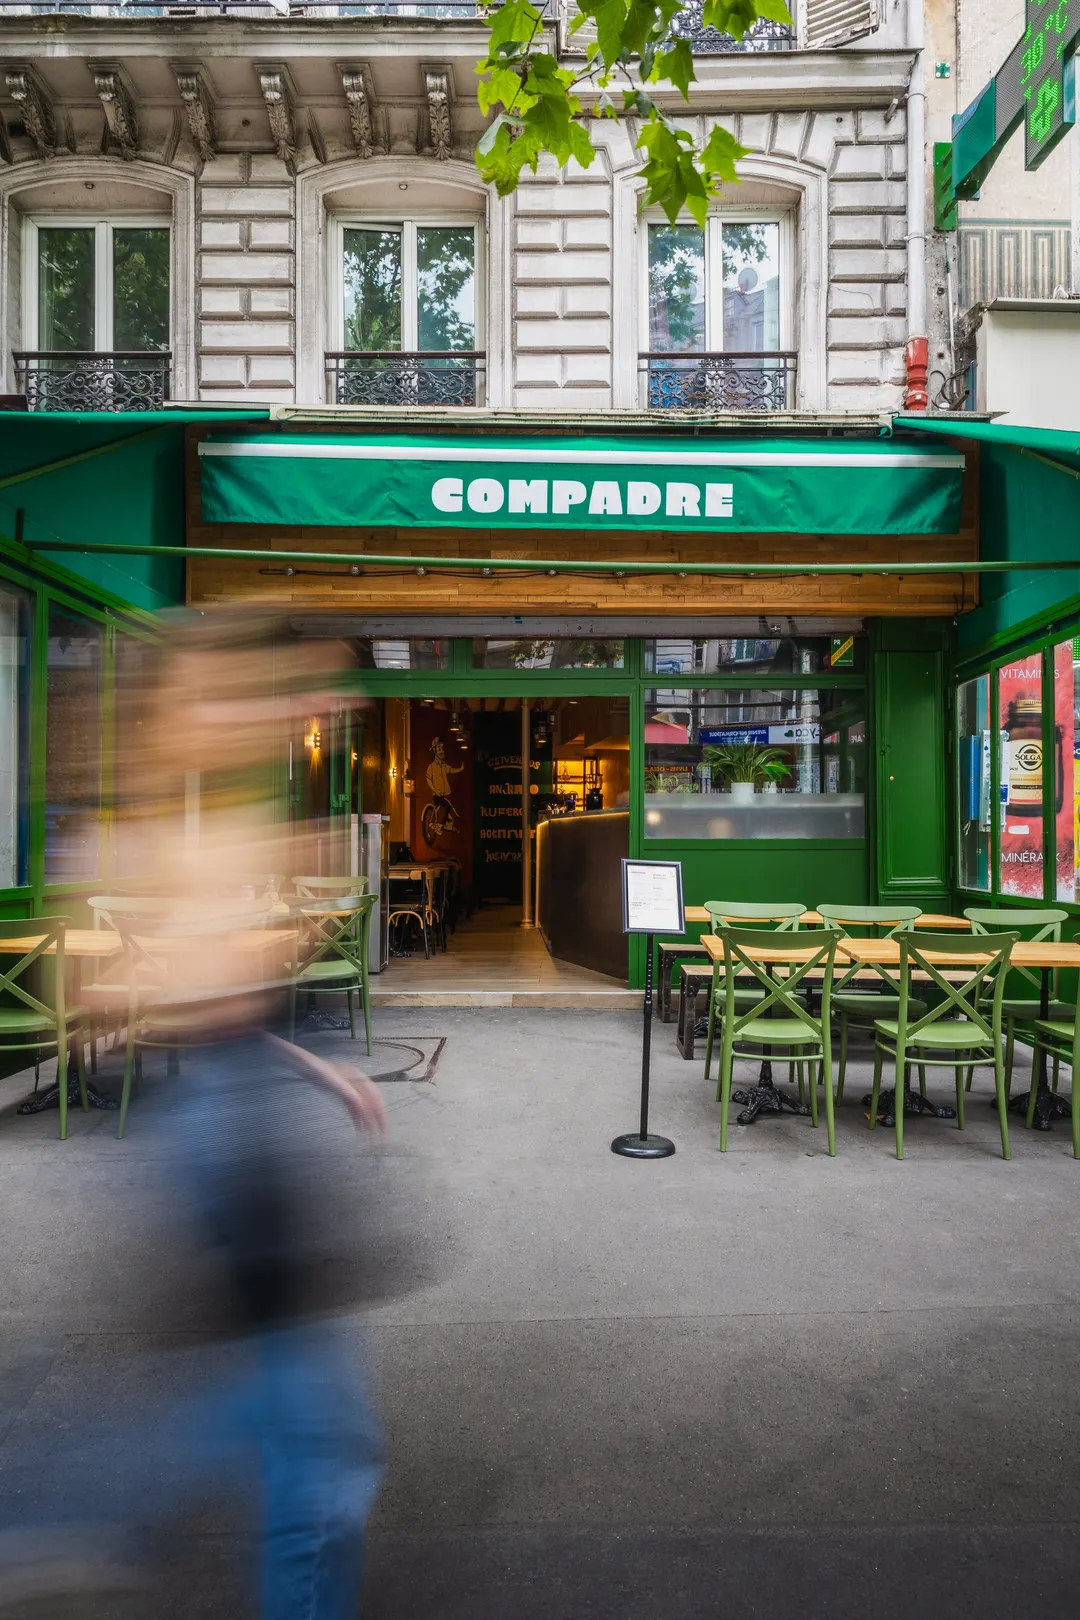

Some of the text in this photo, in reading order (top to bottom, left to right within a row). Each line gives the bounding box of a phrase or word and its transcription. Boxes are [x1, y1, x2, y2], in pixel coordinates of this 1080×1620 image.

[431, 477, 733, 517] COMPADRE
[1000, 669, 1060, 679] VITAMIS
[1015, 753, 1042, 761] SOLGA
[1001, 850, 1060, 863] MINÉRAX
